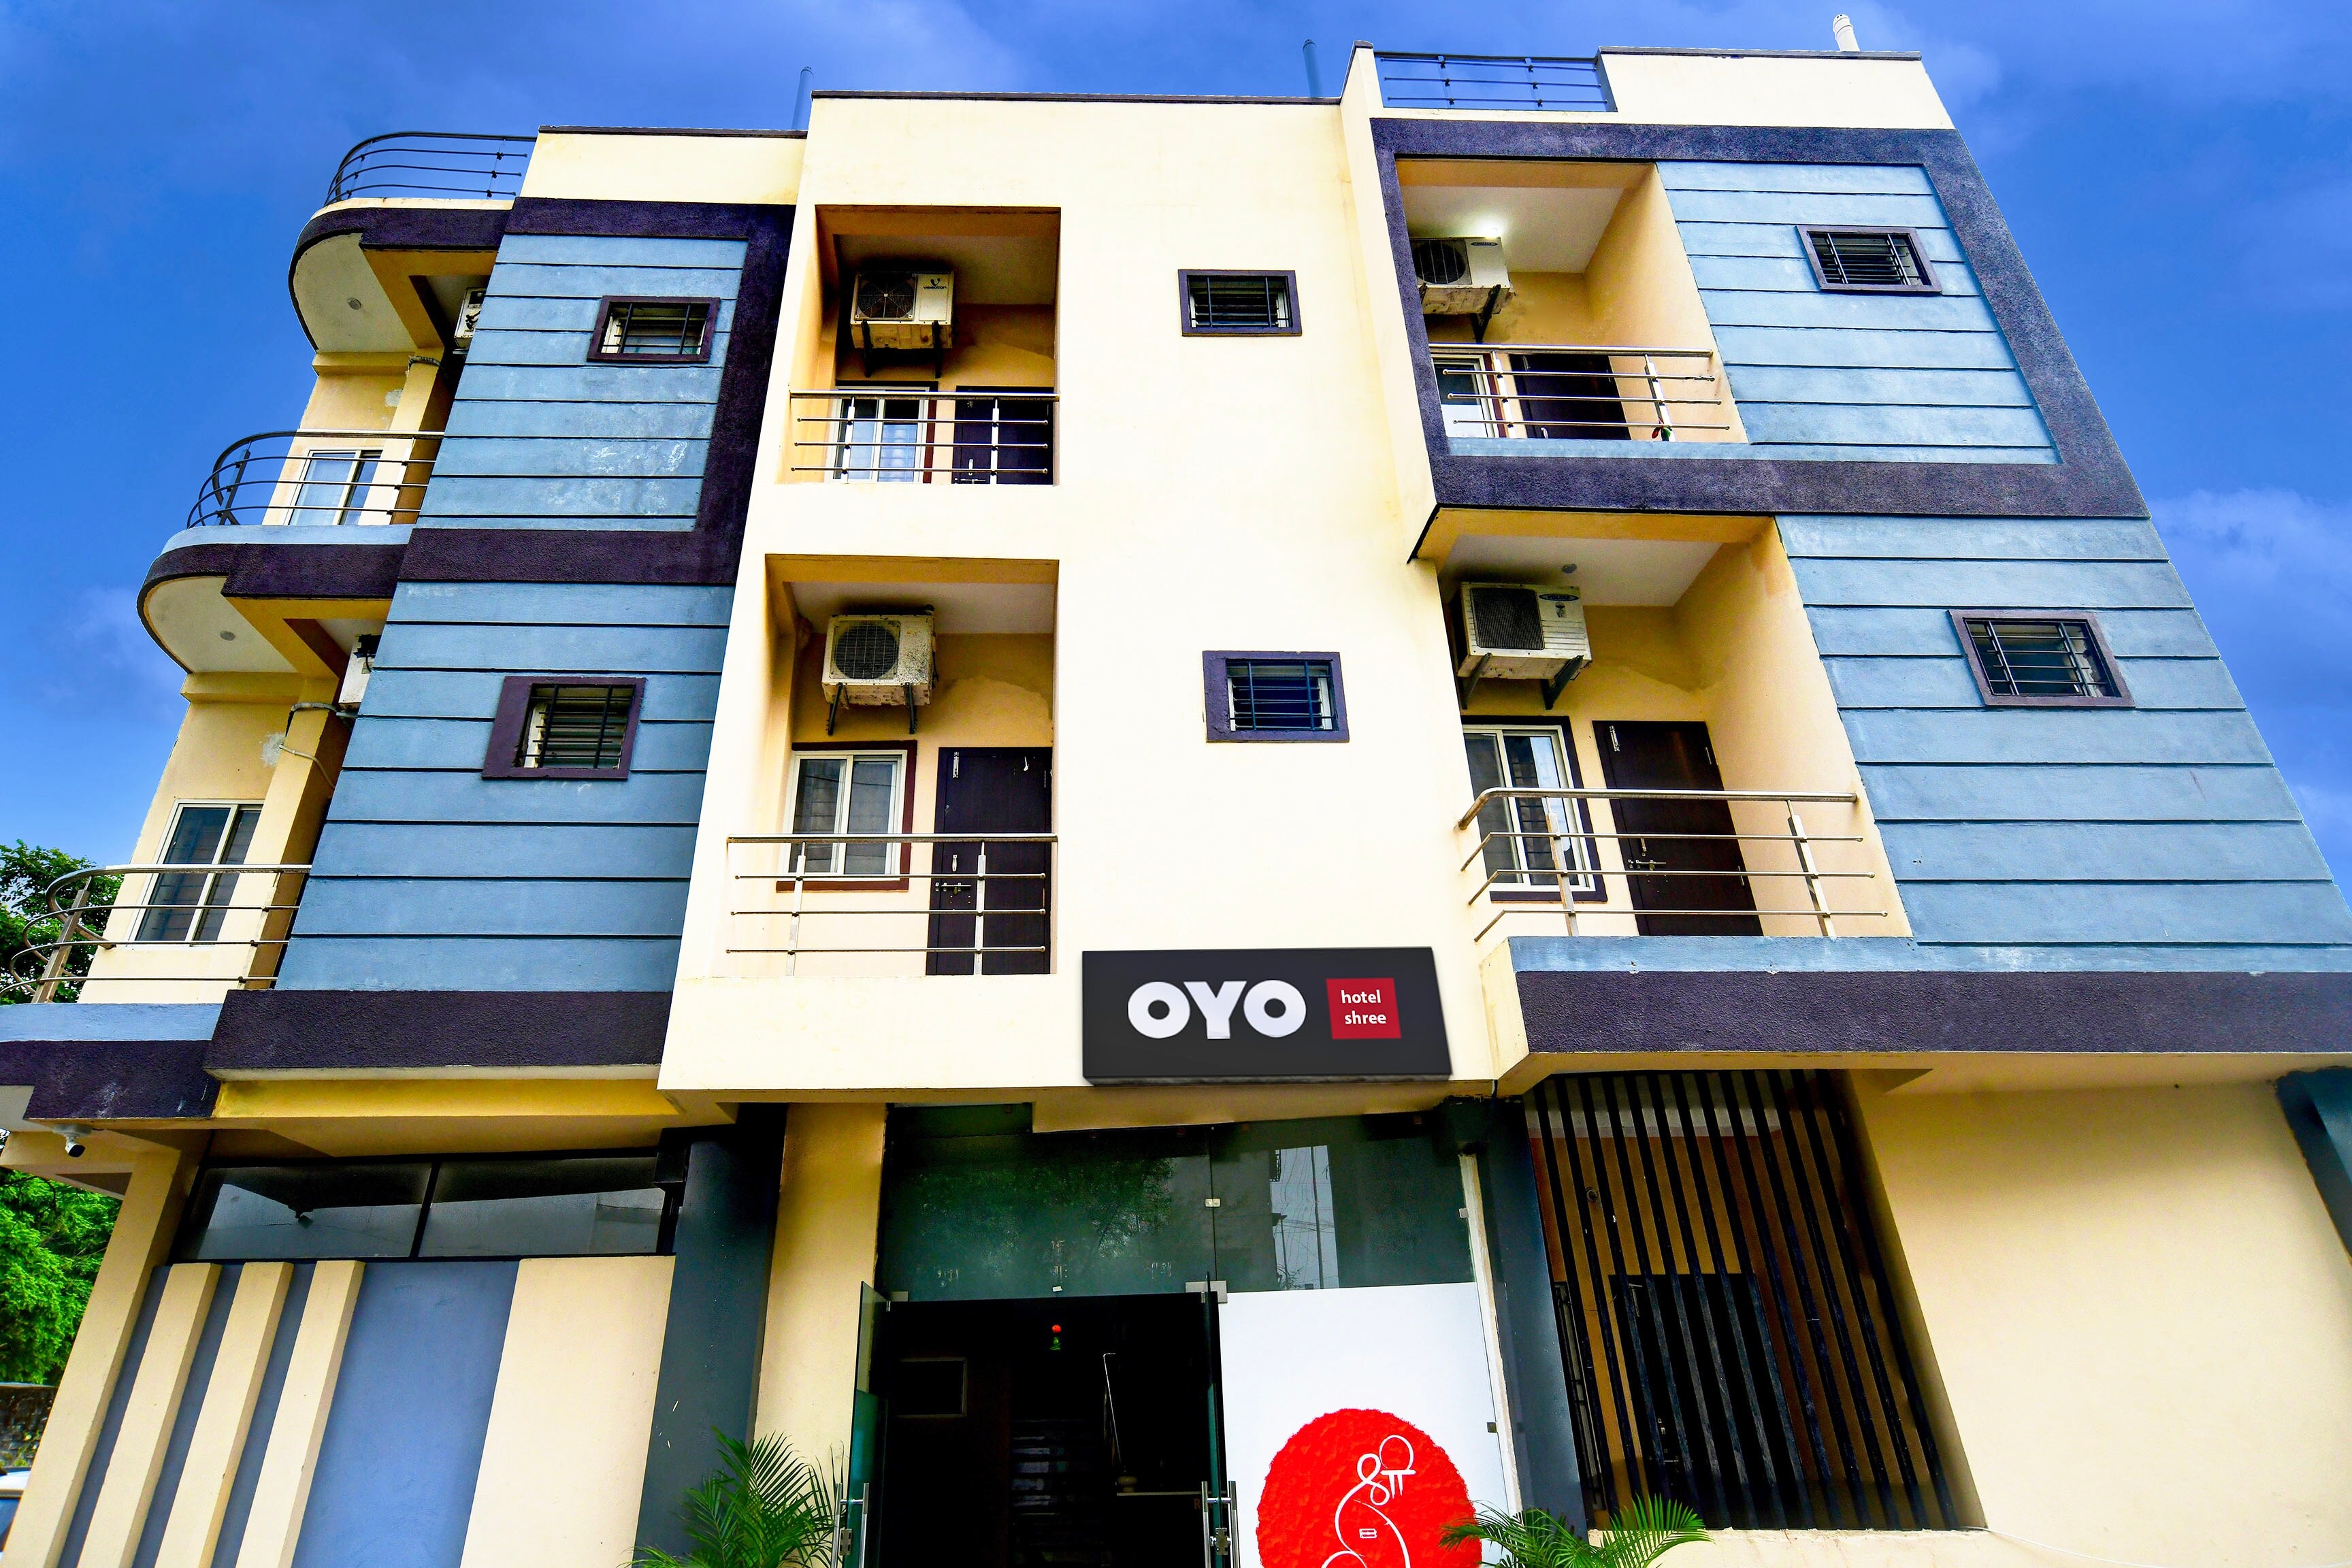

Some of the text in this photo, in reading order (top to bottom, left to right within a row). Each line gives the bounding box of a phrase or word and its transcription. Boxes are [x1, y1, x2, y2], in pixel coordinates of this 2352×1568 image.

[1341, 989, 1382, 1004] hotel
[1128, 979, 1307, 1040] OYO
[1344, 1011, 1387, 1025] shree
